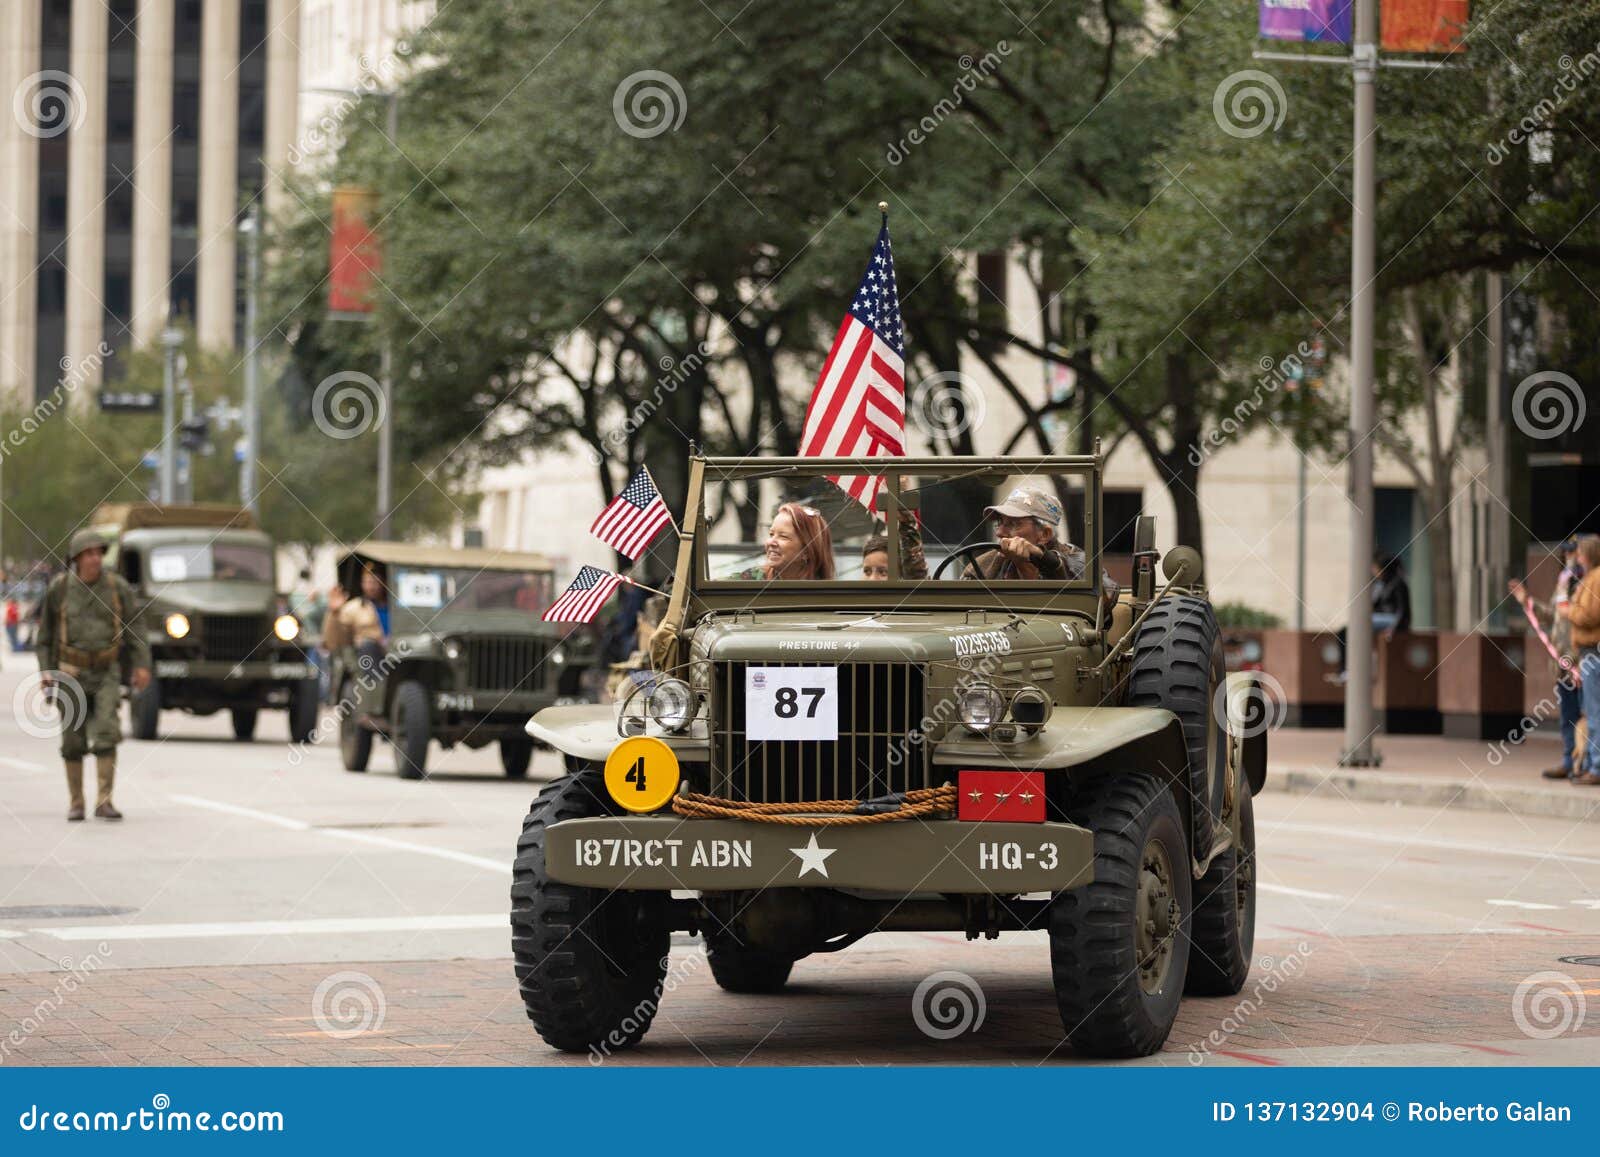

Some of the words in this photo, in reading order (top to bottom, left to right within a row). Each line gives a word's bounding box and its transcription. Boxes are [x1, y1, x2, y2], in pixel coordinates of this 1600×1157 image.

[779, 640, 838, 650] PRESTONE
[844, 641, 861, 650] 44
[774, 687, 826, 718] 87
[625, 757, 647, 791] 4
[575, 839, 683, 867] 187RCT
[690, 839, 752, 867] ABN
[979, 842, 1059, 870] HQ-3
